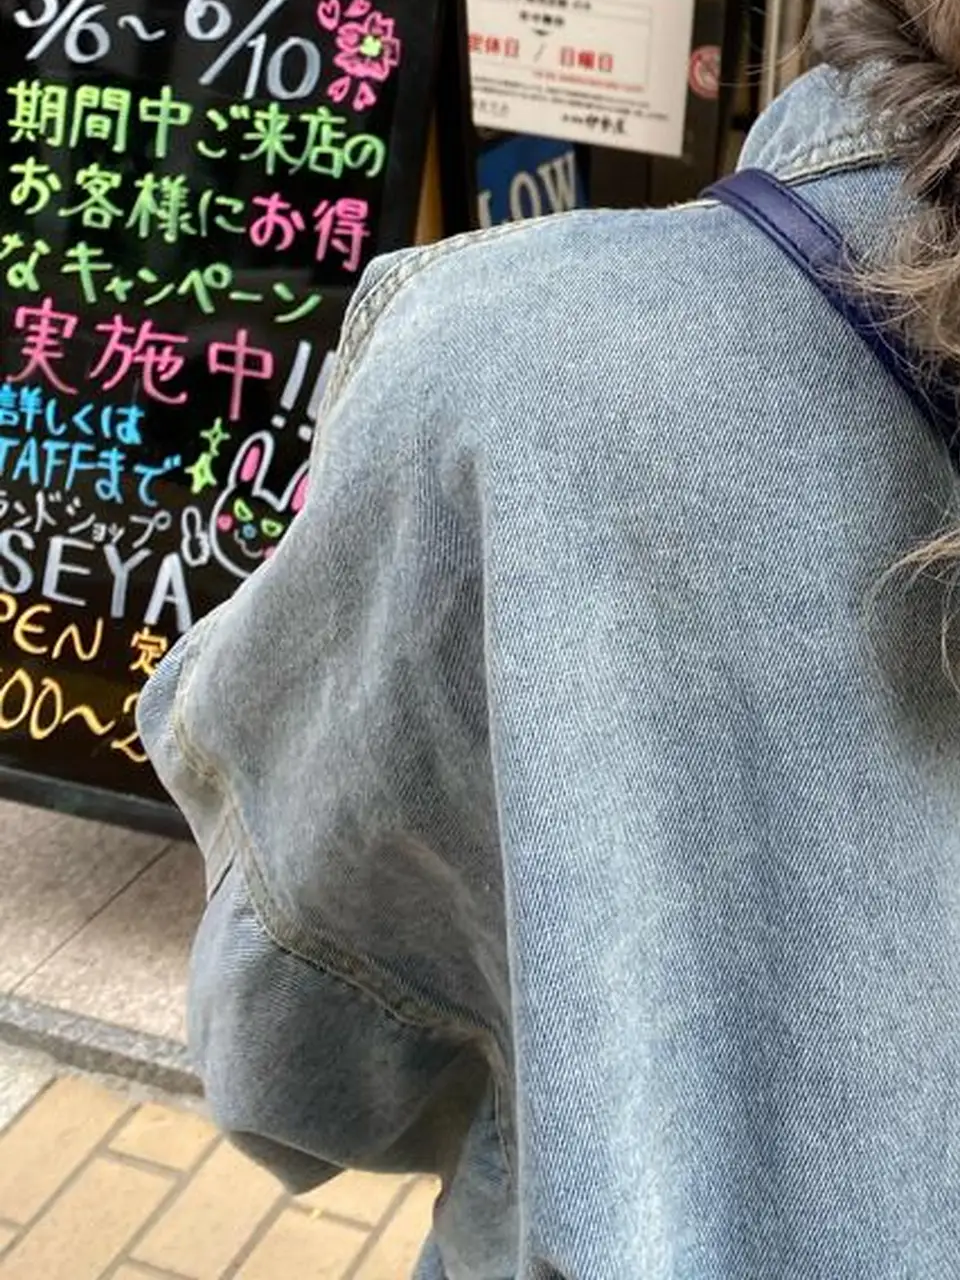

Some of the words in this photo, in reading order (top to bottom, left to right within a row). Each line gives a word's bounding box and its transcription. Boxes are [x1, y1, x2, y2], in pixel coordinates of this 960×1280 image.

[559, 46, 614, 73] 日曜日
[7, 79, 386, 179] 期間中ご来店の
[0, 233, 323, 323] なキャンペーン
[0, 383, 145, 445] 詳しくは
